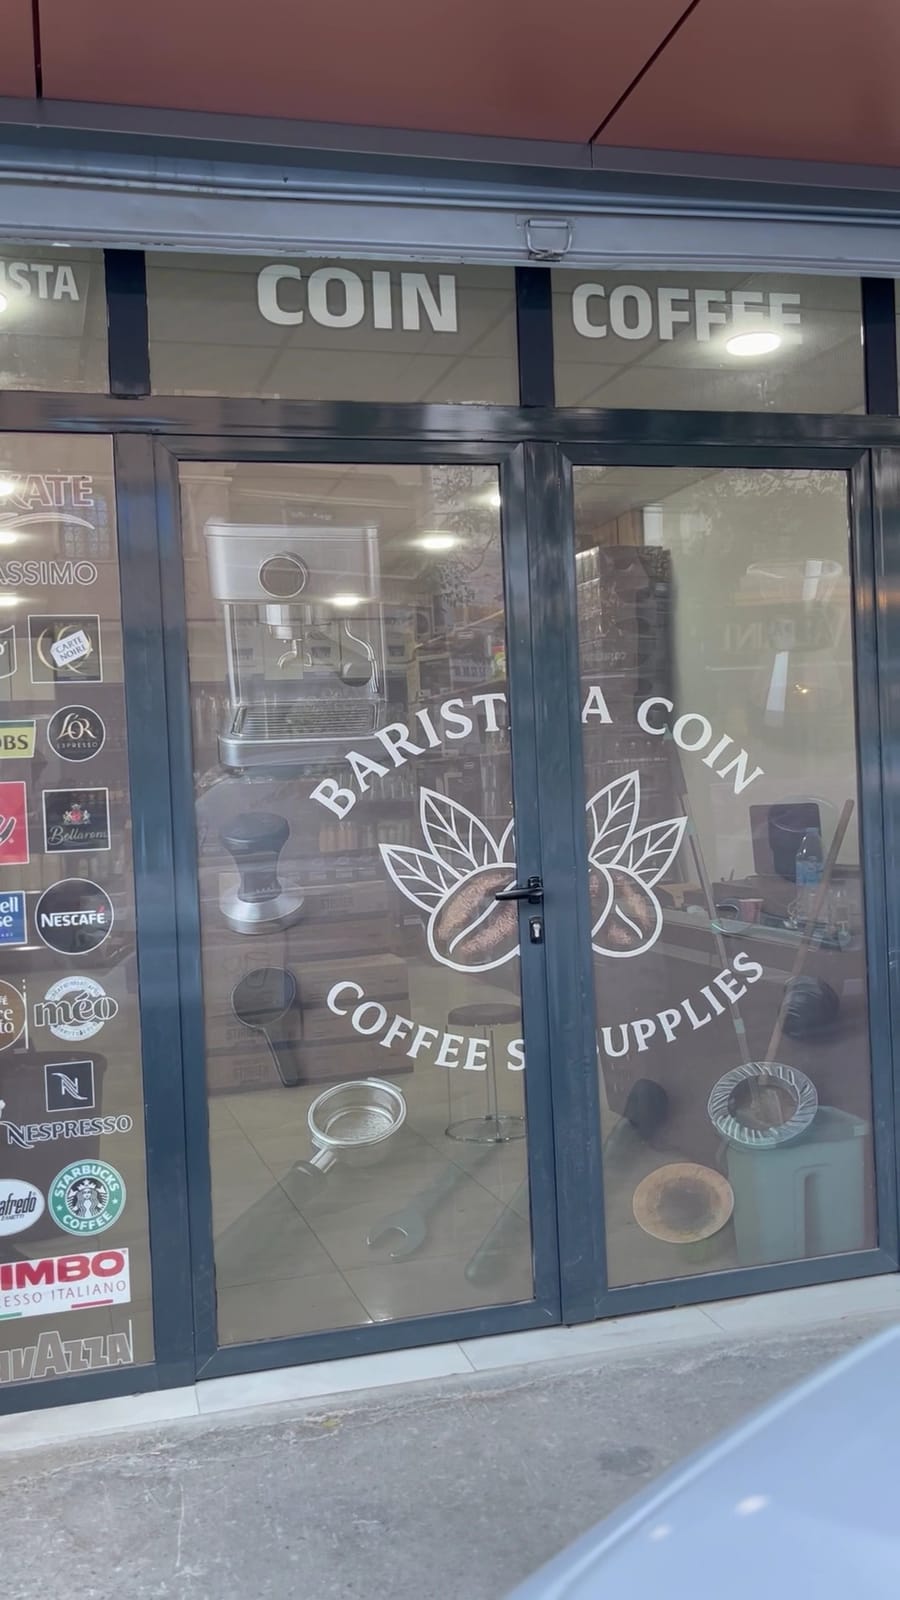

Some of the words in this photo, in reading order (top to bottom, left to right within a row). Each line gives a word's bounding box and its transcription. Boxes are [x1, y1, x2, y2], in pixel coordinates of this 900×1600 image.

[256, 264, 458, 333] COIN
[572, 283, 803, 345] COFFEE
[56, 636, 82, 654] CARTE
[637, 697, 764, 795] COIN
[41, 905, 106, 928] NESCAFÉ
[326, 981, 491, 1071] COFFEE
[0, 1114, 134, 1150] NESPRESSO
[54, 1164, 120, 1198] STARBUCKS
[62, 1210, 113, 1231] COFFEE
[0, 1291, 42, 1309] ESSO
[51, 1280, 127, 1302] ITALIANO
